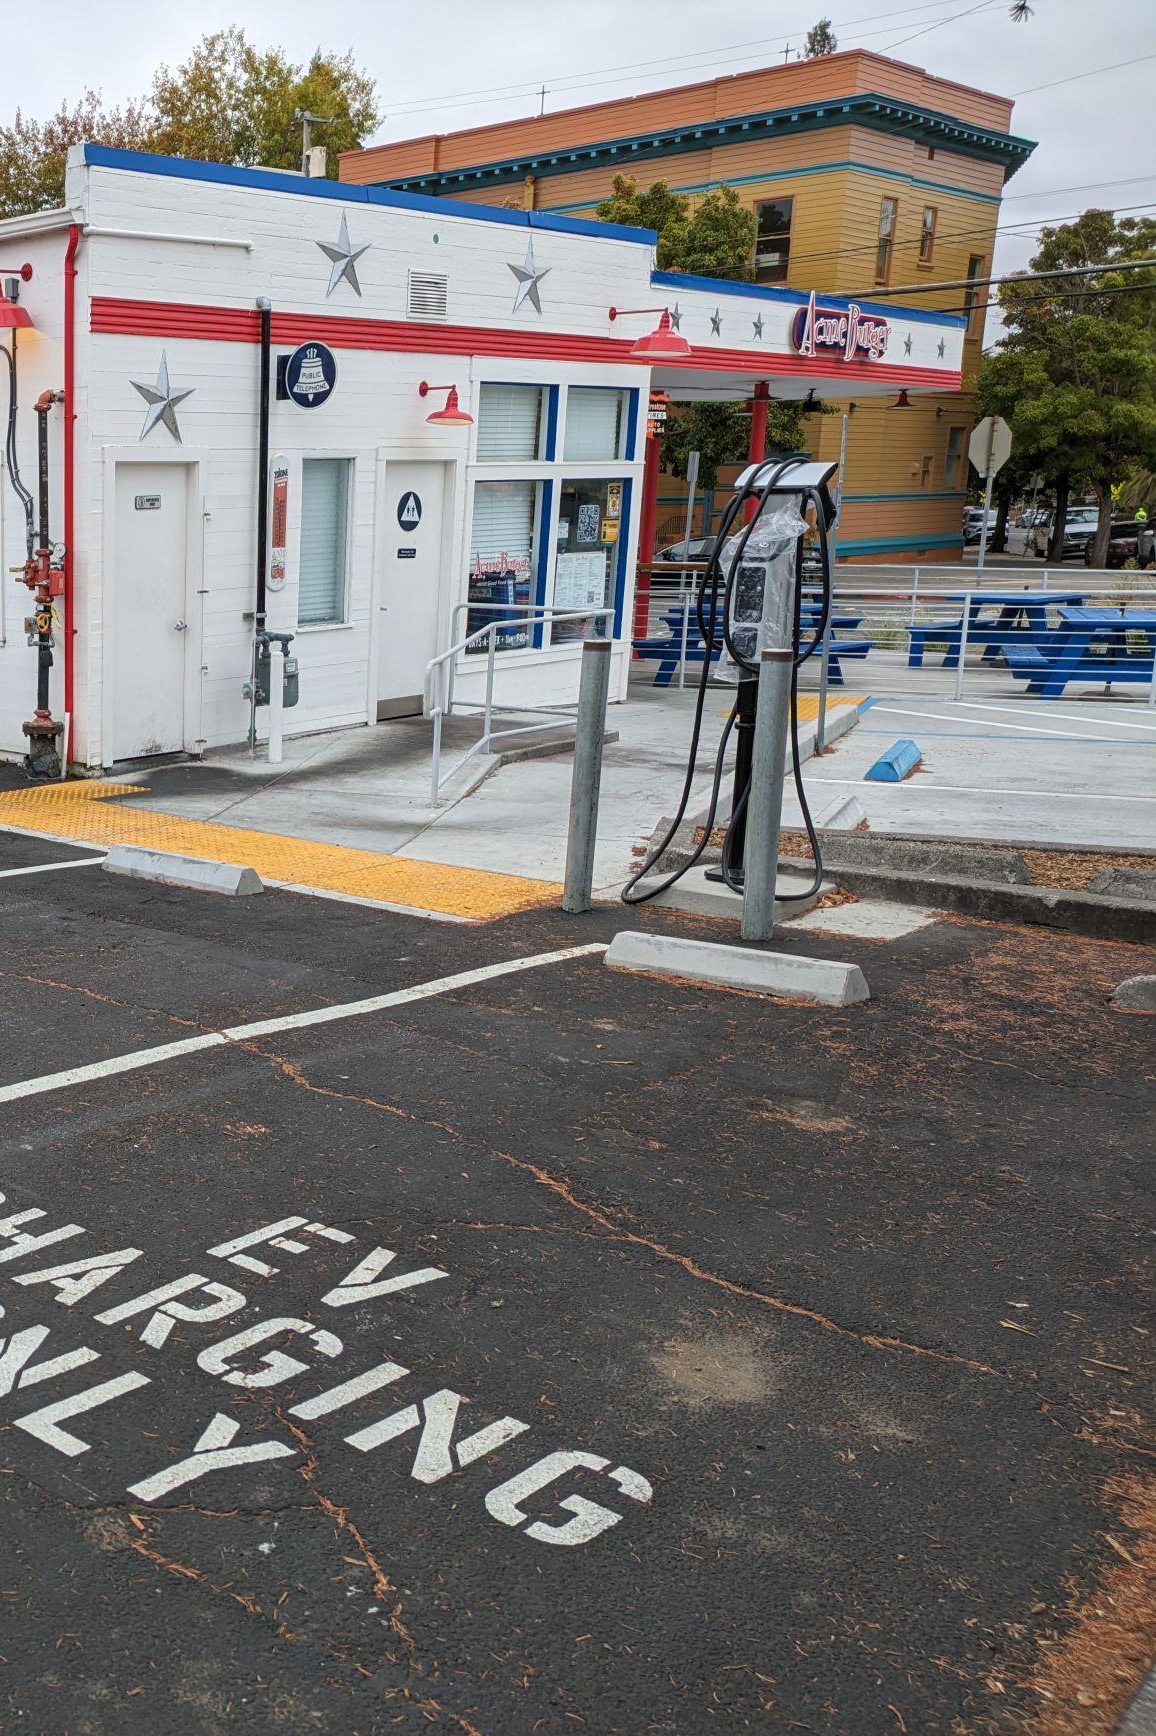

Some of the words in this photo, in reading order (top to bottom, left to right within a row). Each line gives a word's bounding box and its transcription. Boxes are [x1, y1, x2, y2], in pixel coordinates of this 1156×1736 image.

[799, 290, 848, 358] Acme
[844, 303, 892, 362] Burger
[296, 384, 327, 392] TELEPHONE
[301, 371, 321, 380] PUBLIC
[472, 551, 501, 578] Acme
[499, 551, 529, 578] Burger
[207, 1216, 450, 1307] EV
